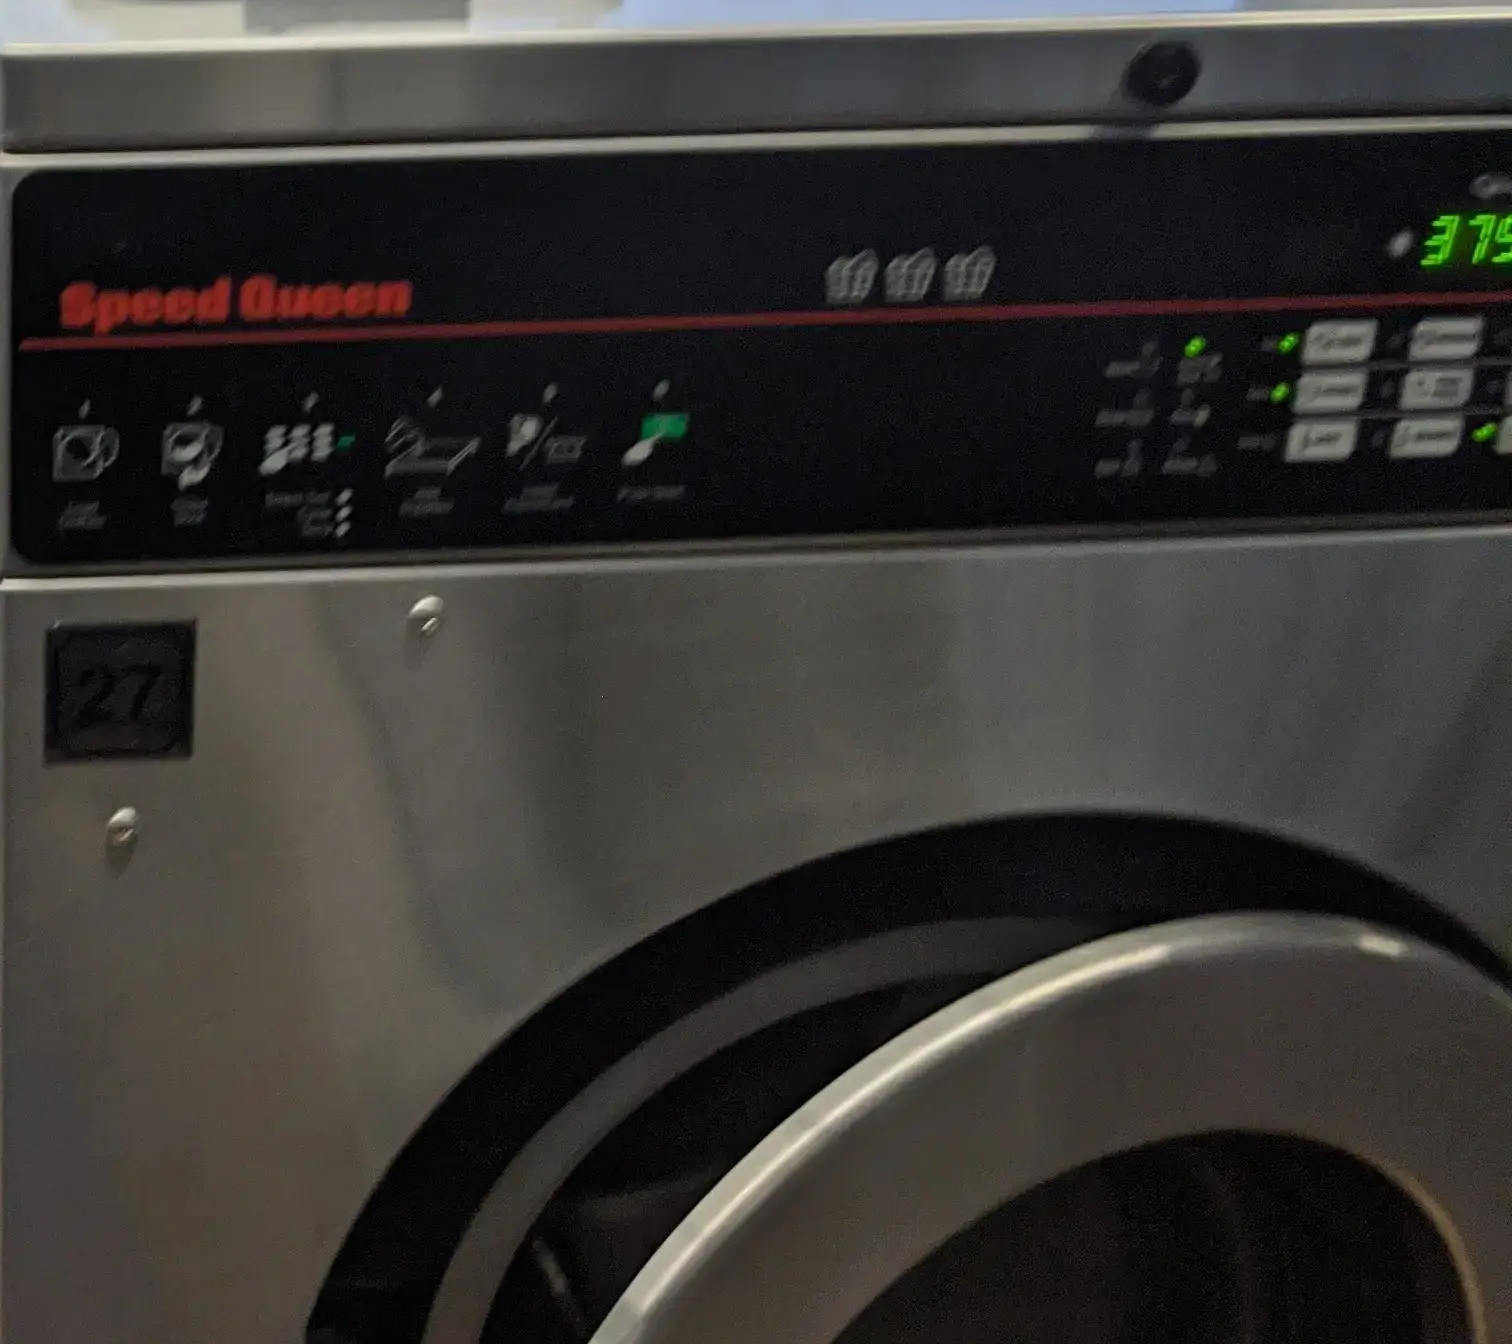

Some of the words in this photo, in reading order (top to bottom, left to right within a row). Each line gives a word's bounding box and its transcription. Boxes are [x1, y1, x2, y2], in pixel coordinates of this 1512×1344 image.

[60, 276, 231, 335] Speed
[240, 273, 412, 321] Queen
[75, 664, 163, 730] 27
